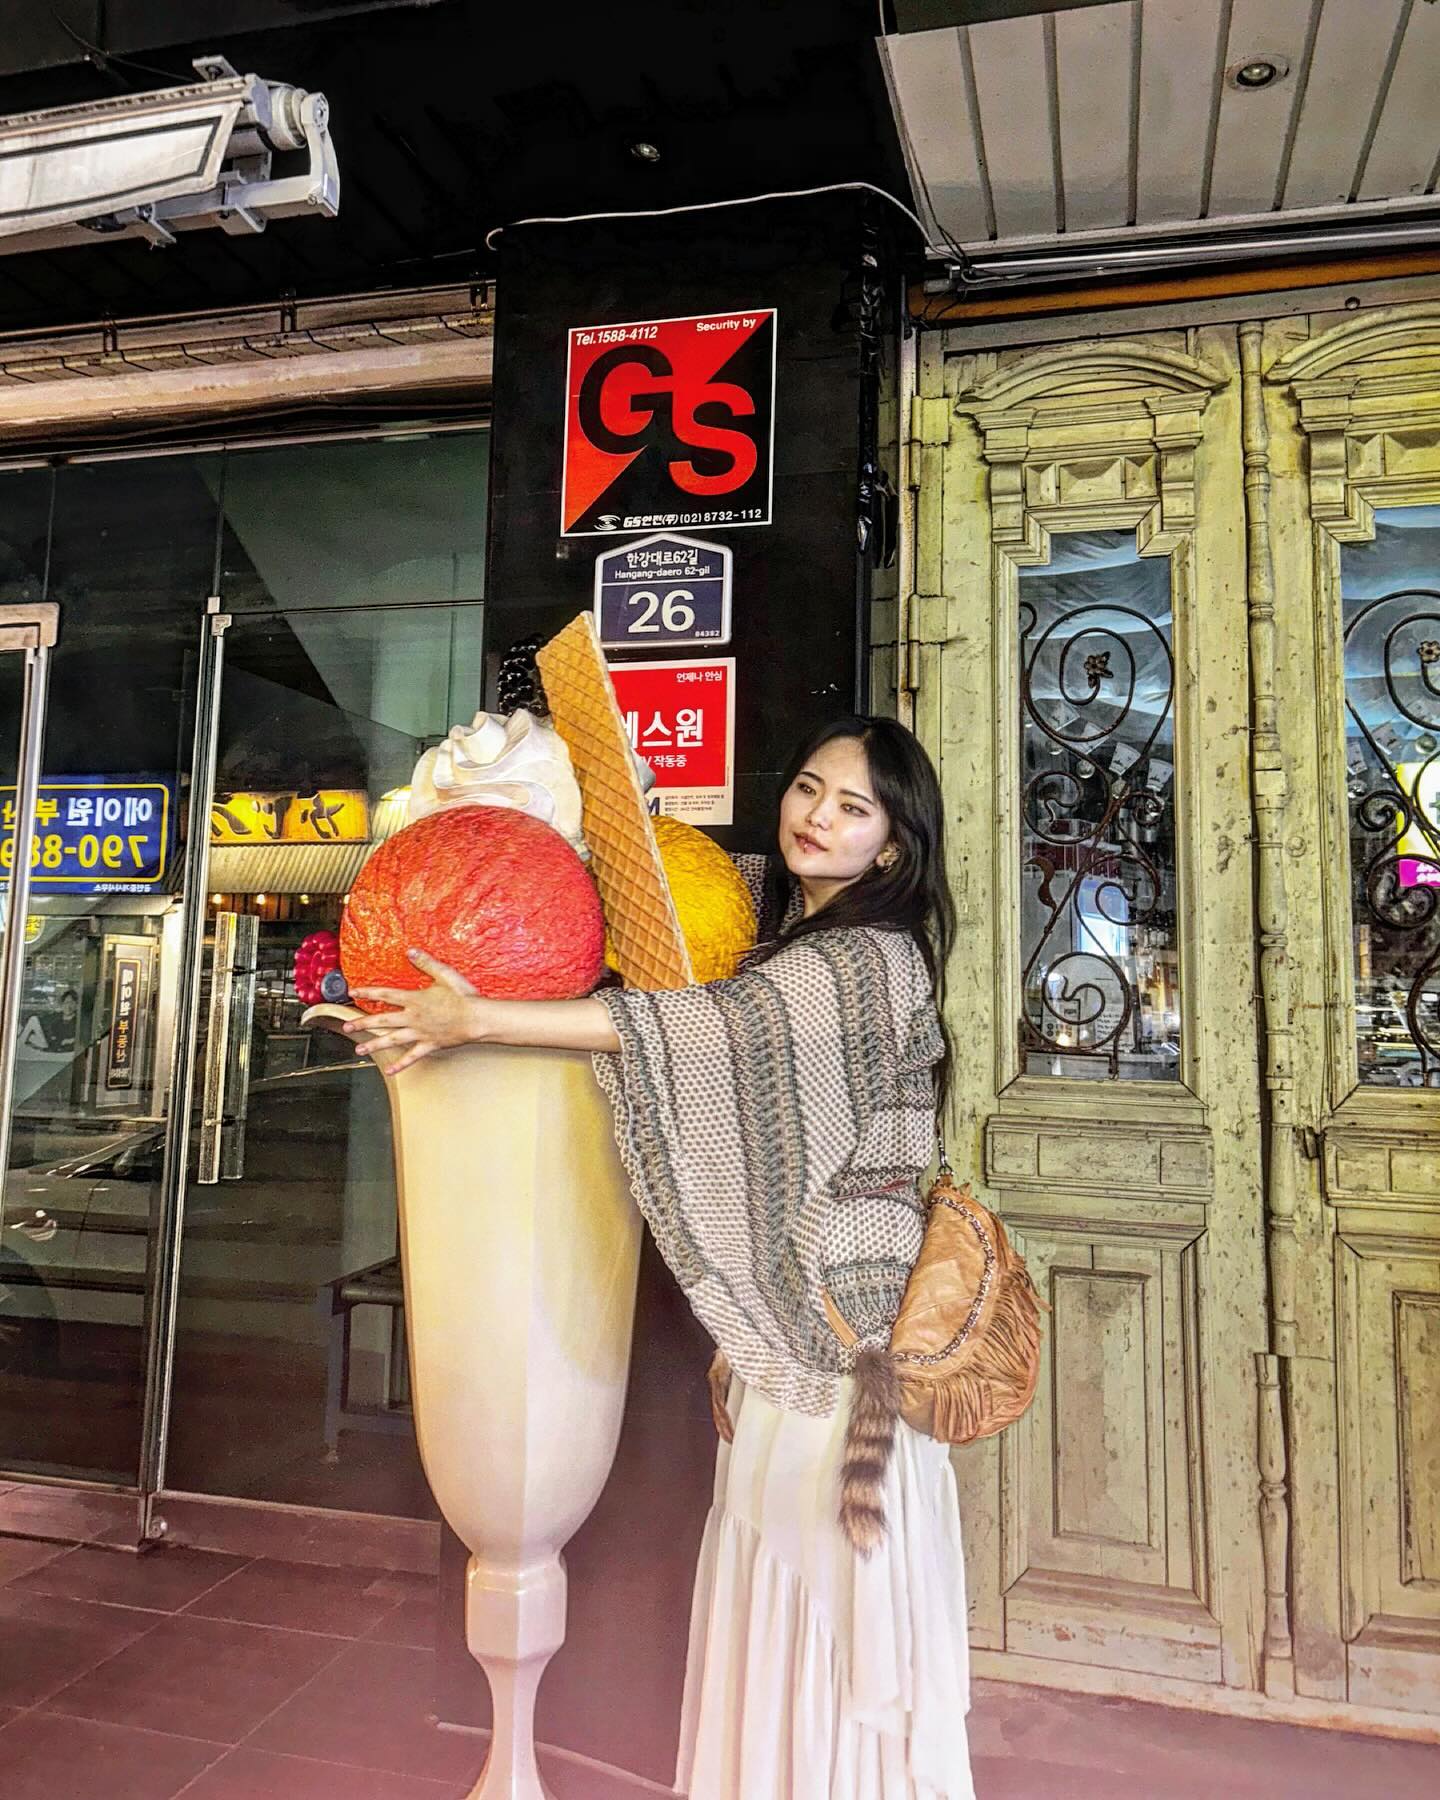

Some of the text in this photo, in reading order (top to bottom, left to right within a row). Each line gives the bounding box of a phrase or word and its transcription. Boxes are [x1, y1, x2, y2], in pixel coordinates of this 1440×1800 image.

[696, 317, 756, 332] Security by
[576, 326, 658, 346] Tel.1588-4112
[578, 344, 758, 496] GS
[626, 548, 699, 568] 한강대로62길
[614, 566, 710, 579] Hangang-daero 62-gil
[628, 589, 695, 633] 26
[676, 670, 722, 682] 언제나 안심
[653, 754, 688, 768] 작동중
